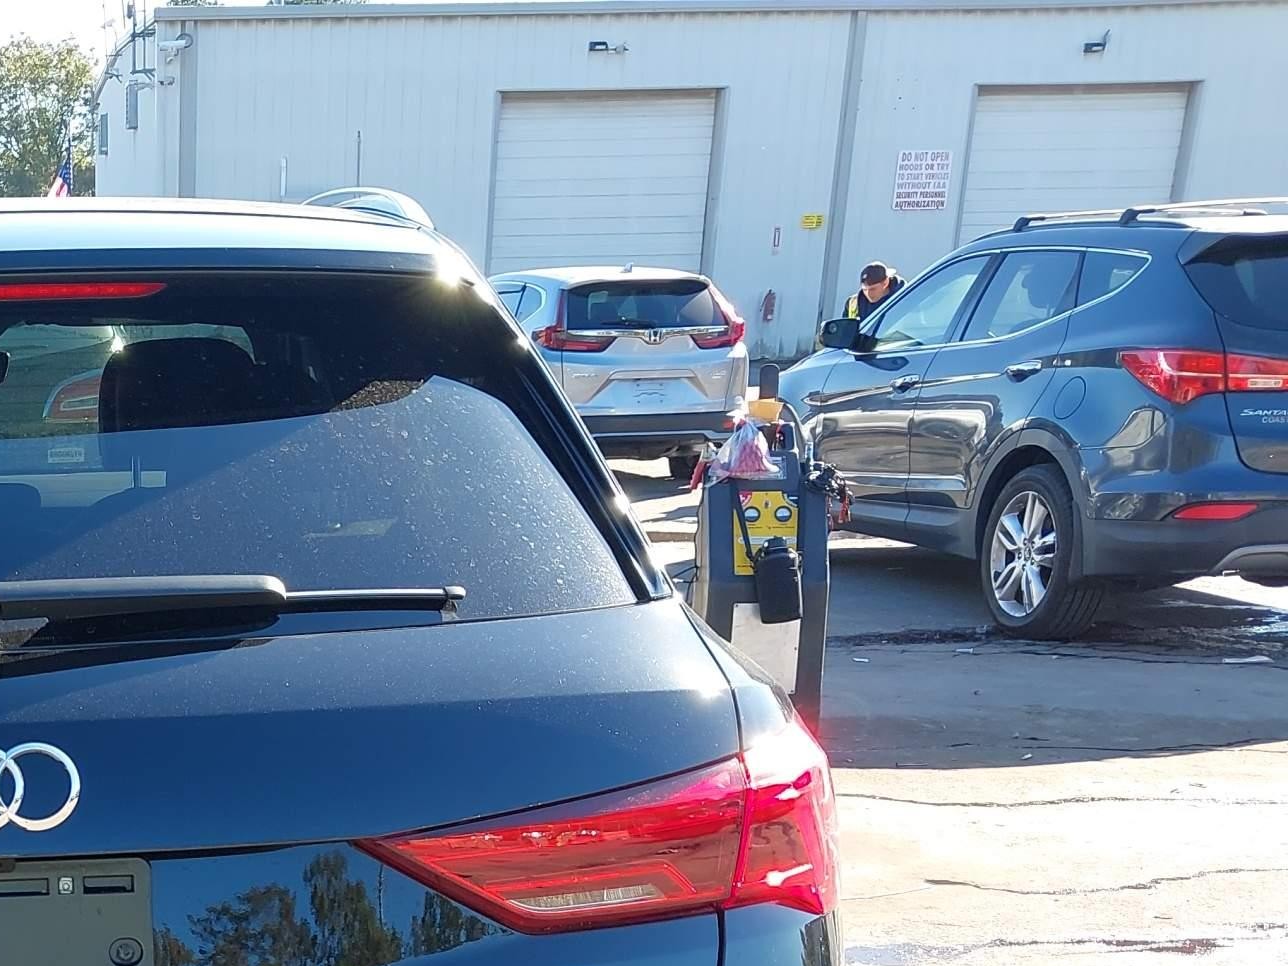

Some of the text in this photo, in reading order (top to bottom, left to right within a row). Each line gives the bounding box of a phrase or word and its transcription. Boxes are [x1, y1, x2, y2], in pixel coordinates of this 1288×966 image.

[902, 152, 950, 162] DO NOT OPEN
[899, 163, 950, 171] HOODS OR TRY
[906, 172, 924, 180] START
[925, 172, 950, 180] VEHICLES
[933, 182, 946, 190] IAA
[896, 191, 946, 199] SECURITY PERSONNEL
[894, 200, 945, 208] AUTHORIZATION
